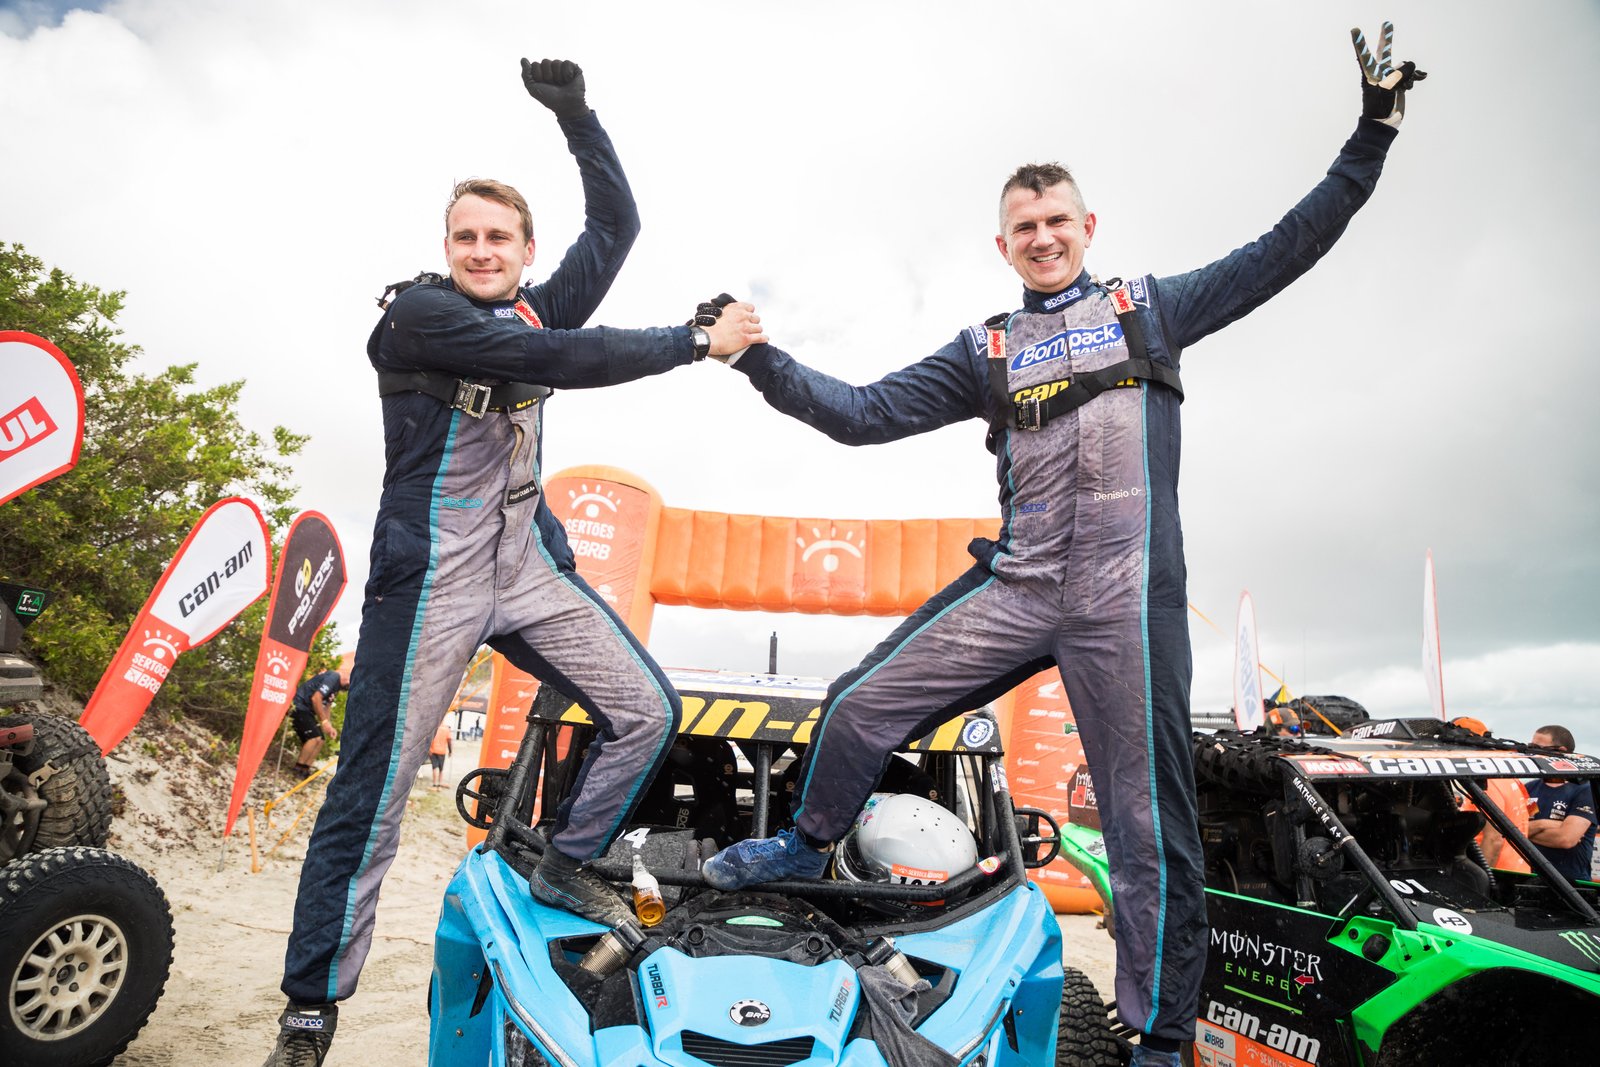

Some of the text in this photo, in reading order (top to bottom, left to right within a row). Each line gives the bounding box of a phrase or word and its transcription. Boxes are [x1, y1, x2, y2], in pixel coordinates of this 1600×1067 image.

[1044, 287, 1080, 308] sparco
[1093, 489, 1129, 501] Denisio
[576, 540, 611, 561] BRB
[1211, 928, 1323, 981] MONSTER
[1224, 962, 1304, 995] ENERGY
[286, 1016, 323, 1028] sparco
[745, 1011, 770, 1020] BRP
[1207, 1000, 1321, 1064] can-am
